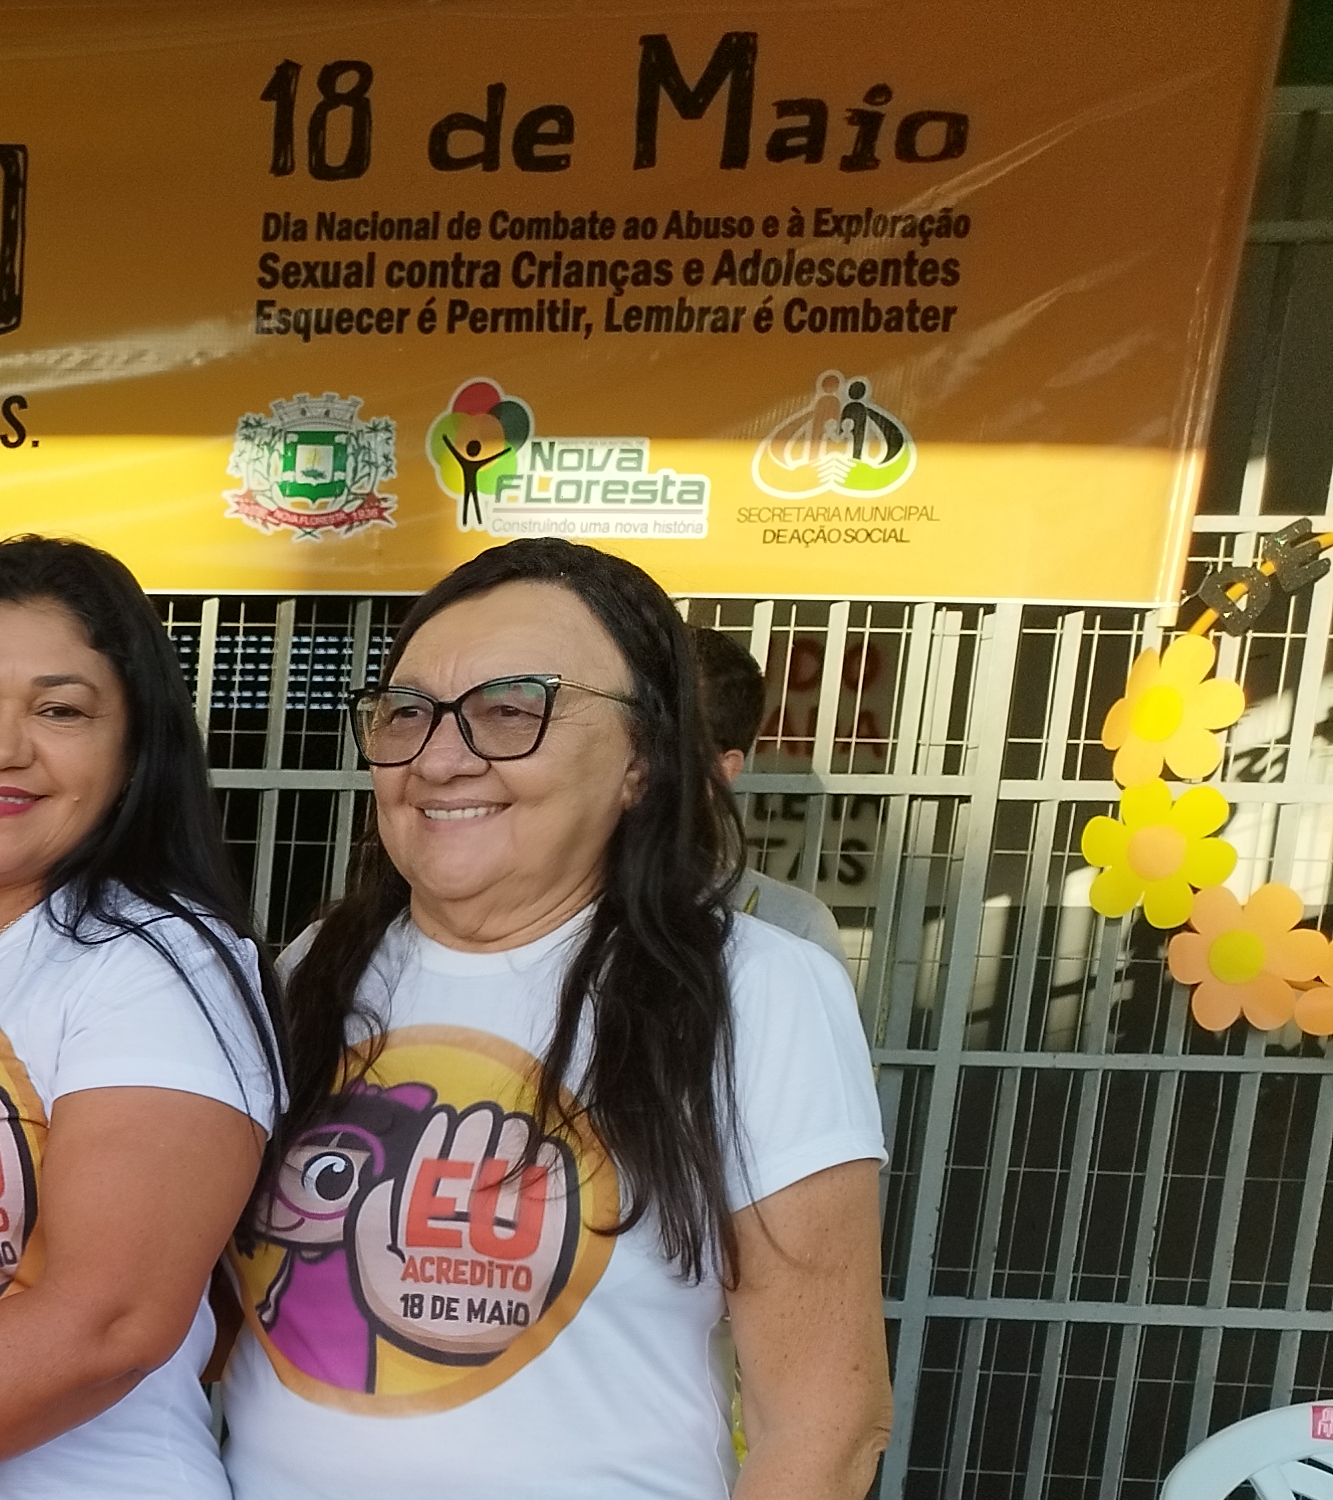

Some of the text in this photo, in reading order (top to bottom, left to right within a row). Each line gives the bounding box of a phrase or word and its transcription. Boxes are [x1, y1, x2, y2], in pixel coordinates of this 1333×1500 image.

[260, 31, 972, 182] 18 de Maio
[262, 205, 972, 247] Dia Nacional de Combate ao Abuso e à Exploração
[256, 248, 961, 296] Sexual contra Crianças e Adolescentes
[255, 295, 958, 343] Esquecer é Permitir, Lembrar é Combater
[530, 442, 644, 473] Nova
[492, 517, 703, 534] Construindo uma nova história
[737, 505, 940, 524] SECRETARIA MUNICIPAL
[762, 525, 910, 548] DE AÇÃO SOCIAL
[405, 1157, 548, 1260] EU
[400, 1293, 425, 1319] 18
[431, 1295, 460, 1321] DE
